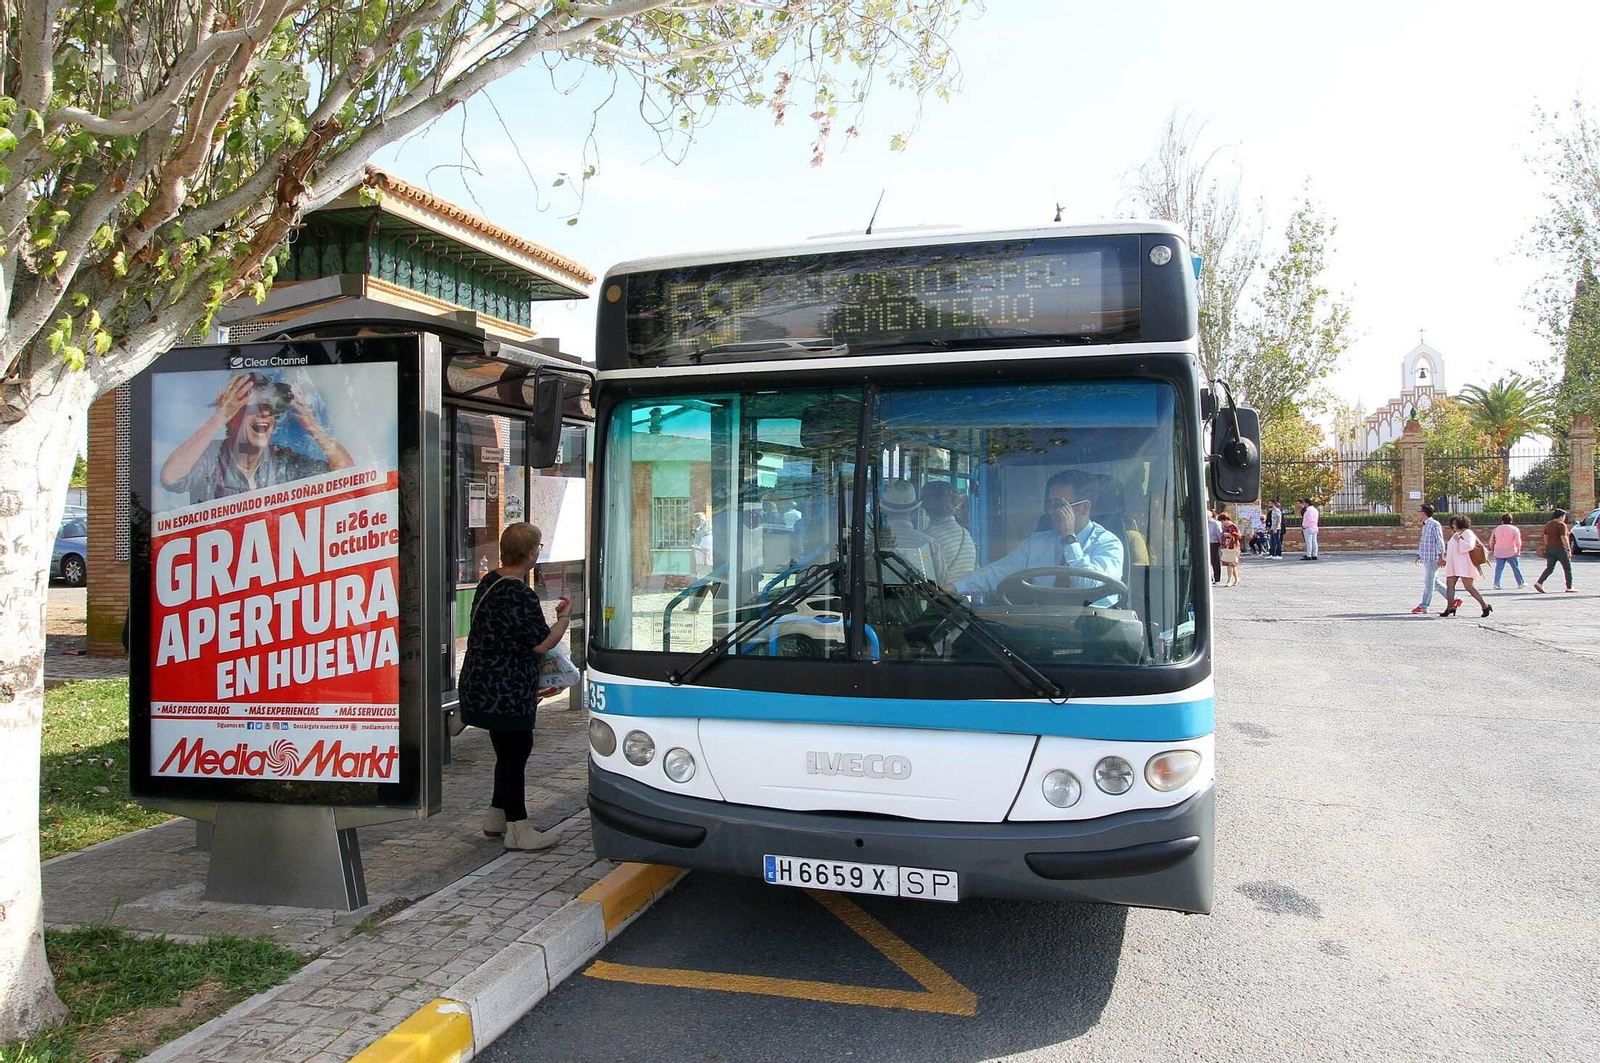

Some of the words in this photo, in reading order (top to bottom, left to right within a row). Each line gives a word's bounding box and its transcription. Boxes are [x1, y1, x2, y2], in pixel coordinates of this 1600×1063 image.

[955, 258, 1080, 294] ESPEC.
[823, 294, 1034, 334] CEMENTERIO
[244, 357, 269, 367] Clear
[270, 355, 308, 366] Channel
[157, 518, 172, 532] UN
[173, 510, 209, 528] ESPACIO
[210, 498, 262, 519] RENOVADO
[264, 491, 289, 506] PARA
[290, 484, 324, 500] SOÑAR
[326, 470, 377, 493] DESPIERTO
[336, 520, 346, 535] El
[348, 509, 369, 532] 26
[371, 512, 387, 526] de
[155, 505, 321, 608] GRAN
[328, 528, 399, 558] octubre
[156, 566, 400, 668] APERTURA
[216, 655, 260, 700] EN
[267, 626, 400, 691] HUELVA
[161, 704, 177, 715] MÁS
[177, 705, 207, 715] PRECIOS
[208, 706, 230, 715] BAJOS
[249, 705, 266, 716] MÁS
[266, 706, 319, 716] EXPERIENCIAS
[339, 706, 357, 716] MÁS
[357, 707, 397, 717] SERVICIOS
[589, 682, 606, 711] 35
[158, 737, 268, 776] Media
[293, 739, 399, 779] Markt
[806, 750, 912, 781] IVECO
